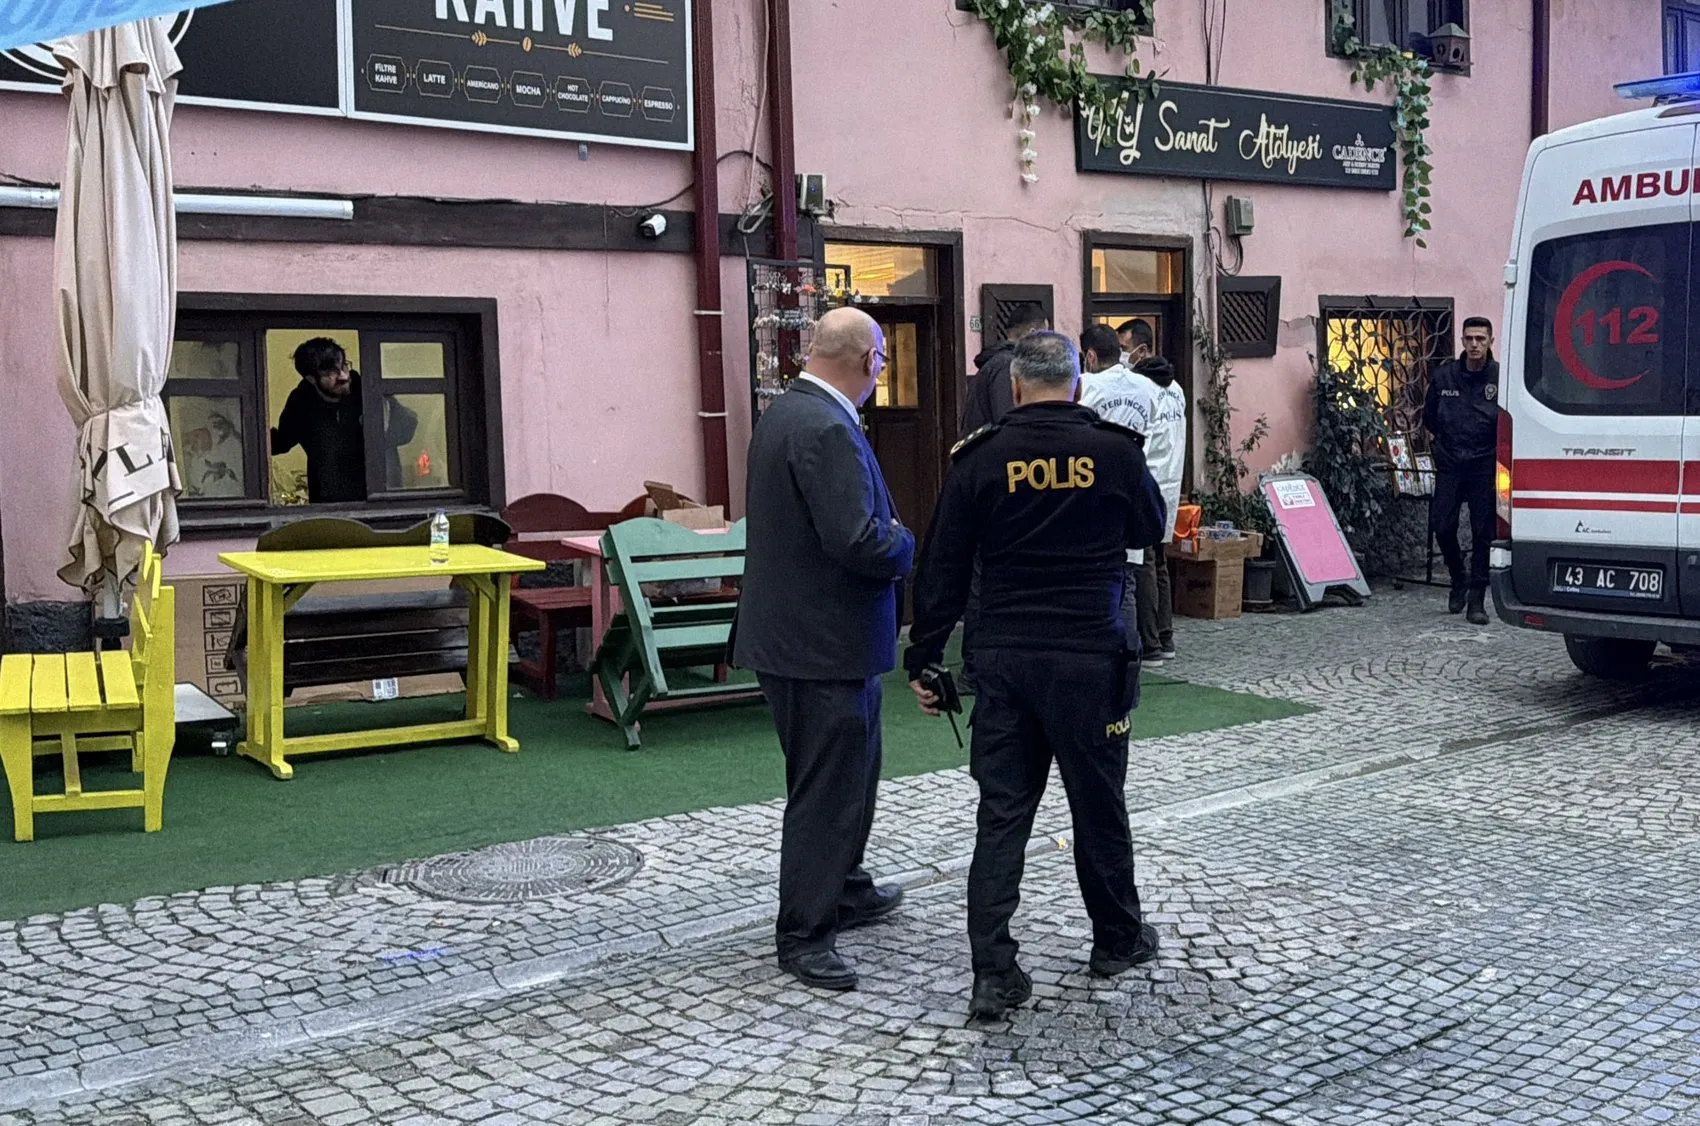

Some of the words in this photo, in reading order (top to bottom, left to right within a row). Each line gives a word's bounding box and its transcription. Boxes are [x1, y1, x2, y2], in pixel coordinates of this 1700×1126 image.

[375, 75, 398, 85] KAHVE
[423, 73, 446, 84] LATTE
[516, 84, 542, 96] MOCHA
[567, 84, 579, 93] HOT
[557, 91, 588, 102] CHOCOLATE
[644, 99, 673, 110] ESPRESSO
[1154, 100, 1231, 153] Sanat
[1239, 112, 1322, 175] Atölyesi
[1331, 144, 1386, 163] CADENCE
[1573, 305, 1659, 347] 112
[1562, 447, 1636, 456] TRANSIT
[1006, 456, 1095, 493] POLIS
[1565, 566, 1584, 585] 43
[1596, 569, 1616, 588] AC
[1629, 571, 1659, 591] 708
